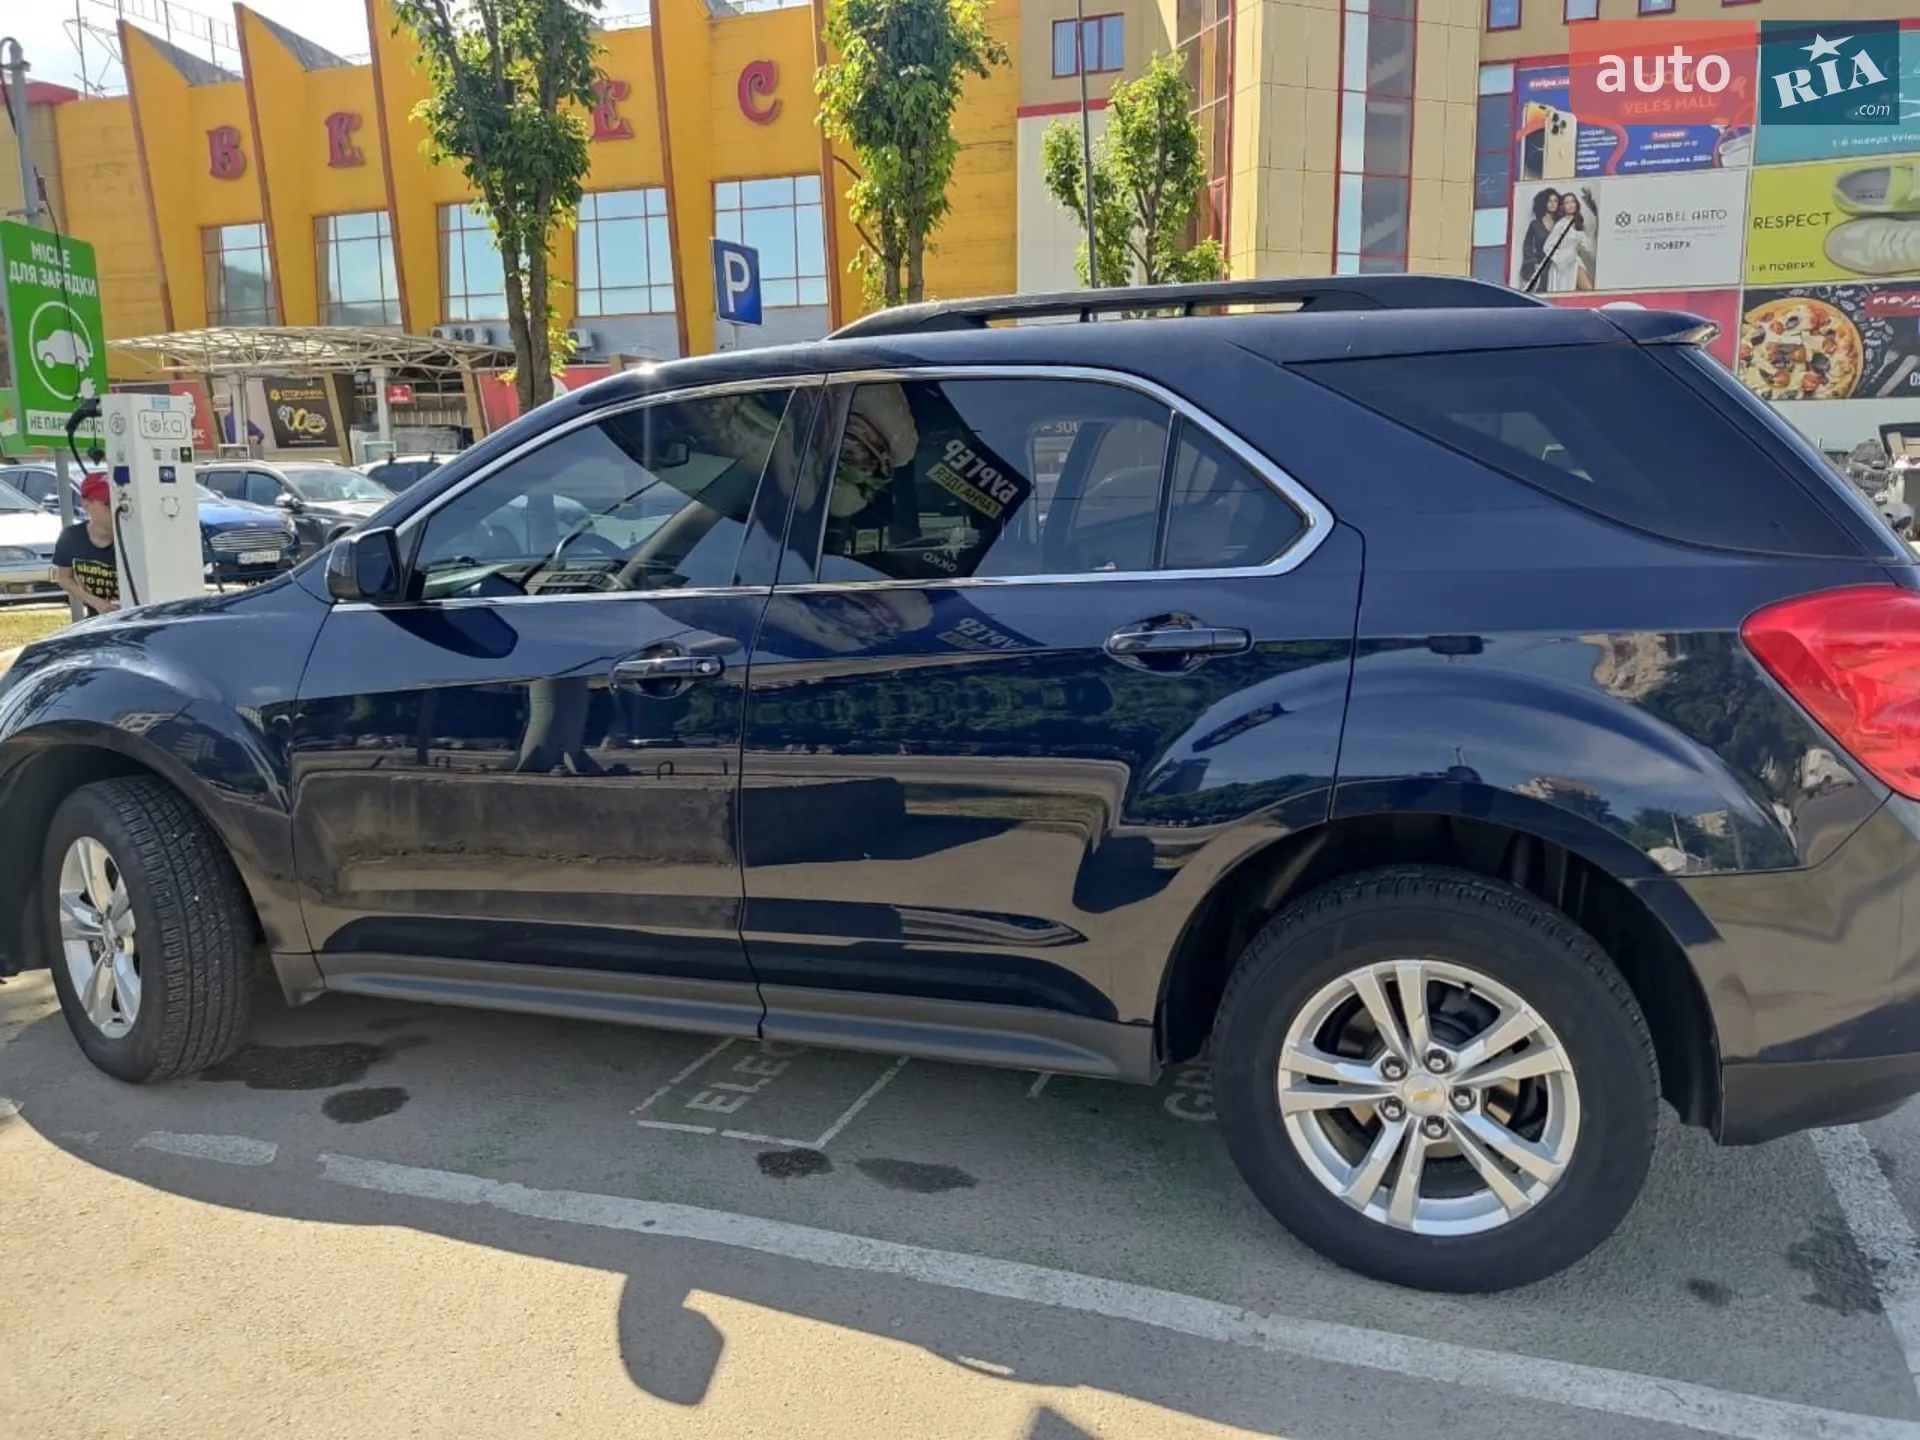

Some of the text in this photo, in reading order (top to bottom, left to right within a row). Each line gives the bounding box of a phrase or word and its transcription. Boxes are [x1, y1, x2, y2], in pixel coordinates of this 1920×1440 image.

[1624, 97, 1718, 115] VELES MALL
[1691, 209, 1728, 221] ARTO
[1753, 212, 1833, 230] RESPECT
[9, 260, 97, 298] ДЛЯ ЗАРЯДКИ
[724, 250, 750, 313] P
[30, 415, 42, 430] НЕ
